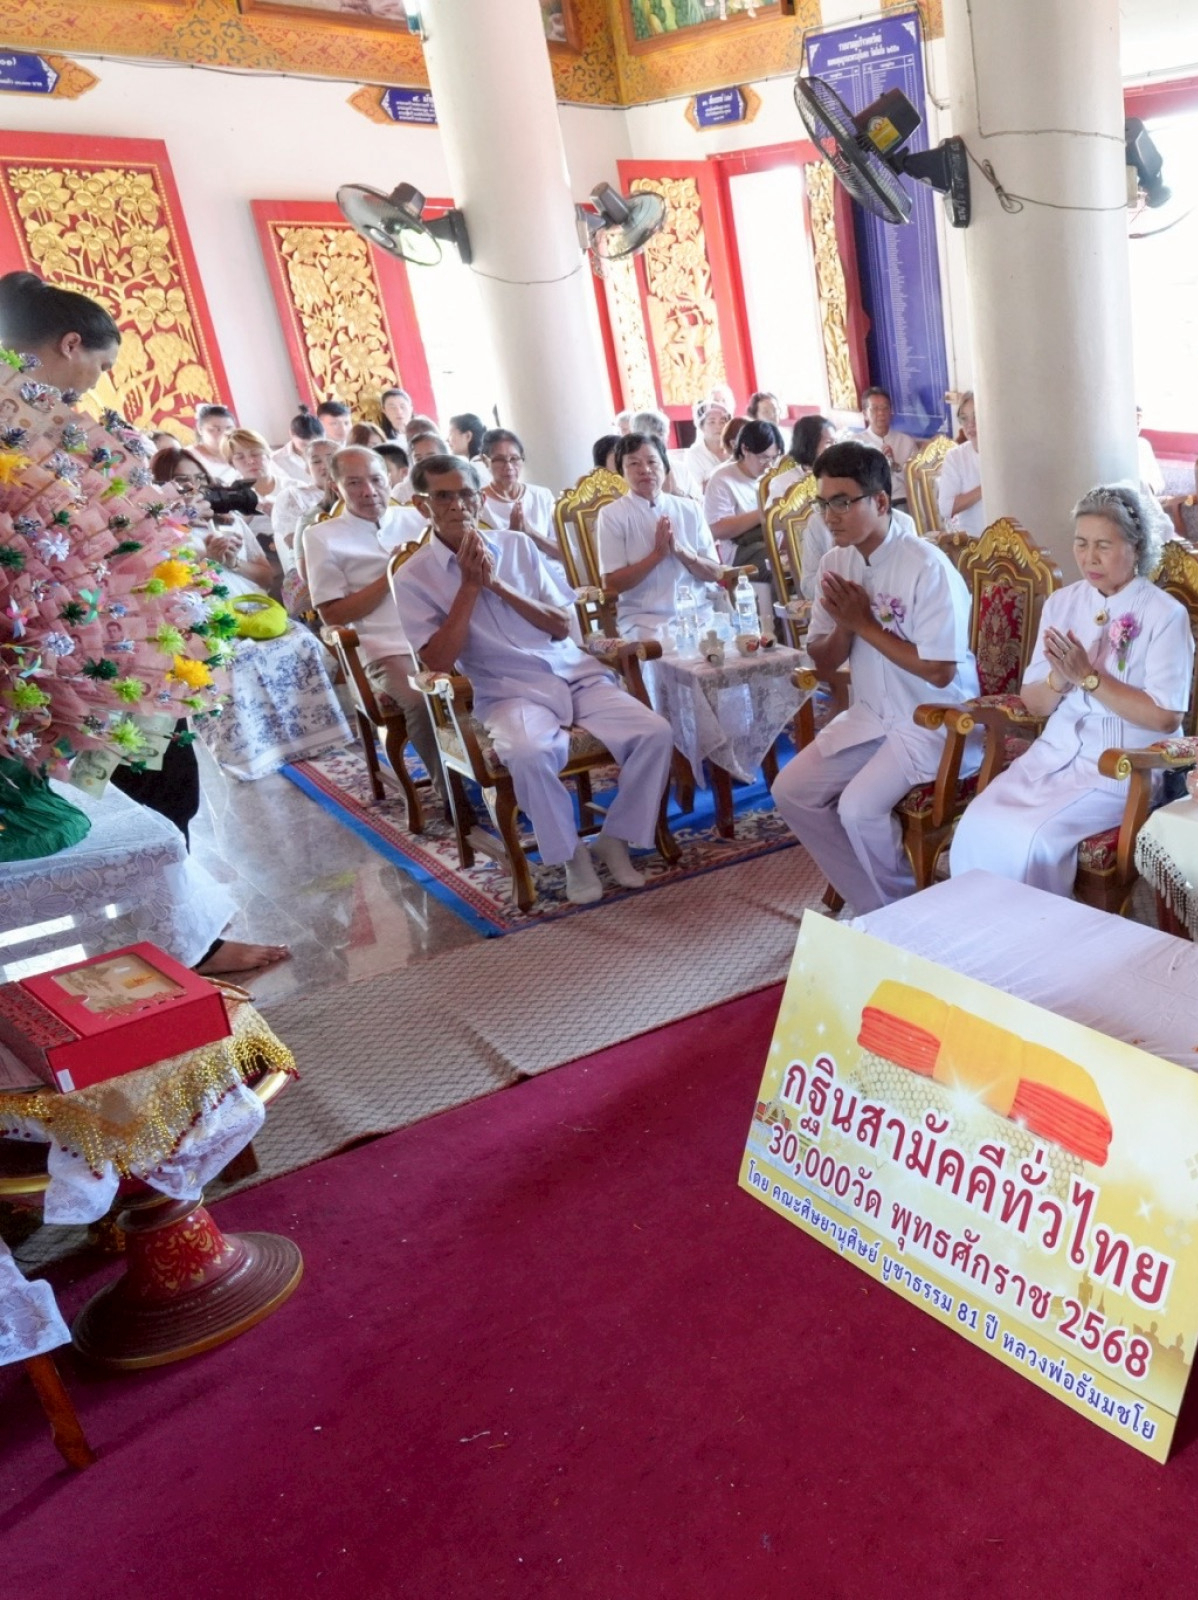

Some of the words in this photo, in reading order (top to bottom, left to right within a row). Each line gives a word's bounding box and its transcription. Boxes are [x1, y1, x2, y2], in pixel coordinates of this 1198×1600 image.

[747, 1159, 769, 1192] โดย
[772, 1185, 881, 1263] คณะศิษยานุศิษย์
[882, 1255, 953, 1313] บูชาธรรม
[957, 1302, 979, 1330] 81
[984, 1313, 999, 1340] ปี
[1002, 1332, 1156, 1440] หลวงพ่อธัมมชโย
[768, 1125, 883, 1219] 30,000วัด
[891, 1202, 1052, 1320] พุทธศักราช
[1058, 1299, 1150, 1378] 2568
[783, 1056, 1170, 1304] กฐินสามัคคีทั่วไทย
